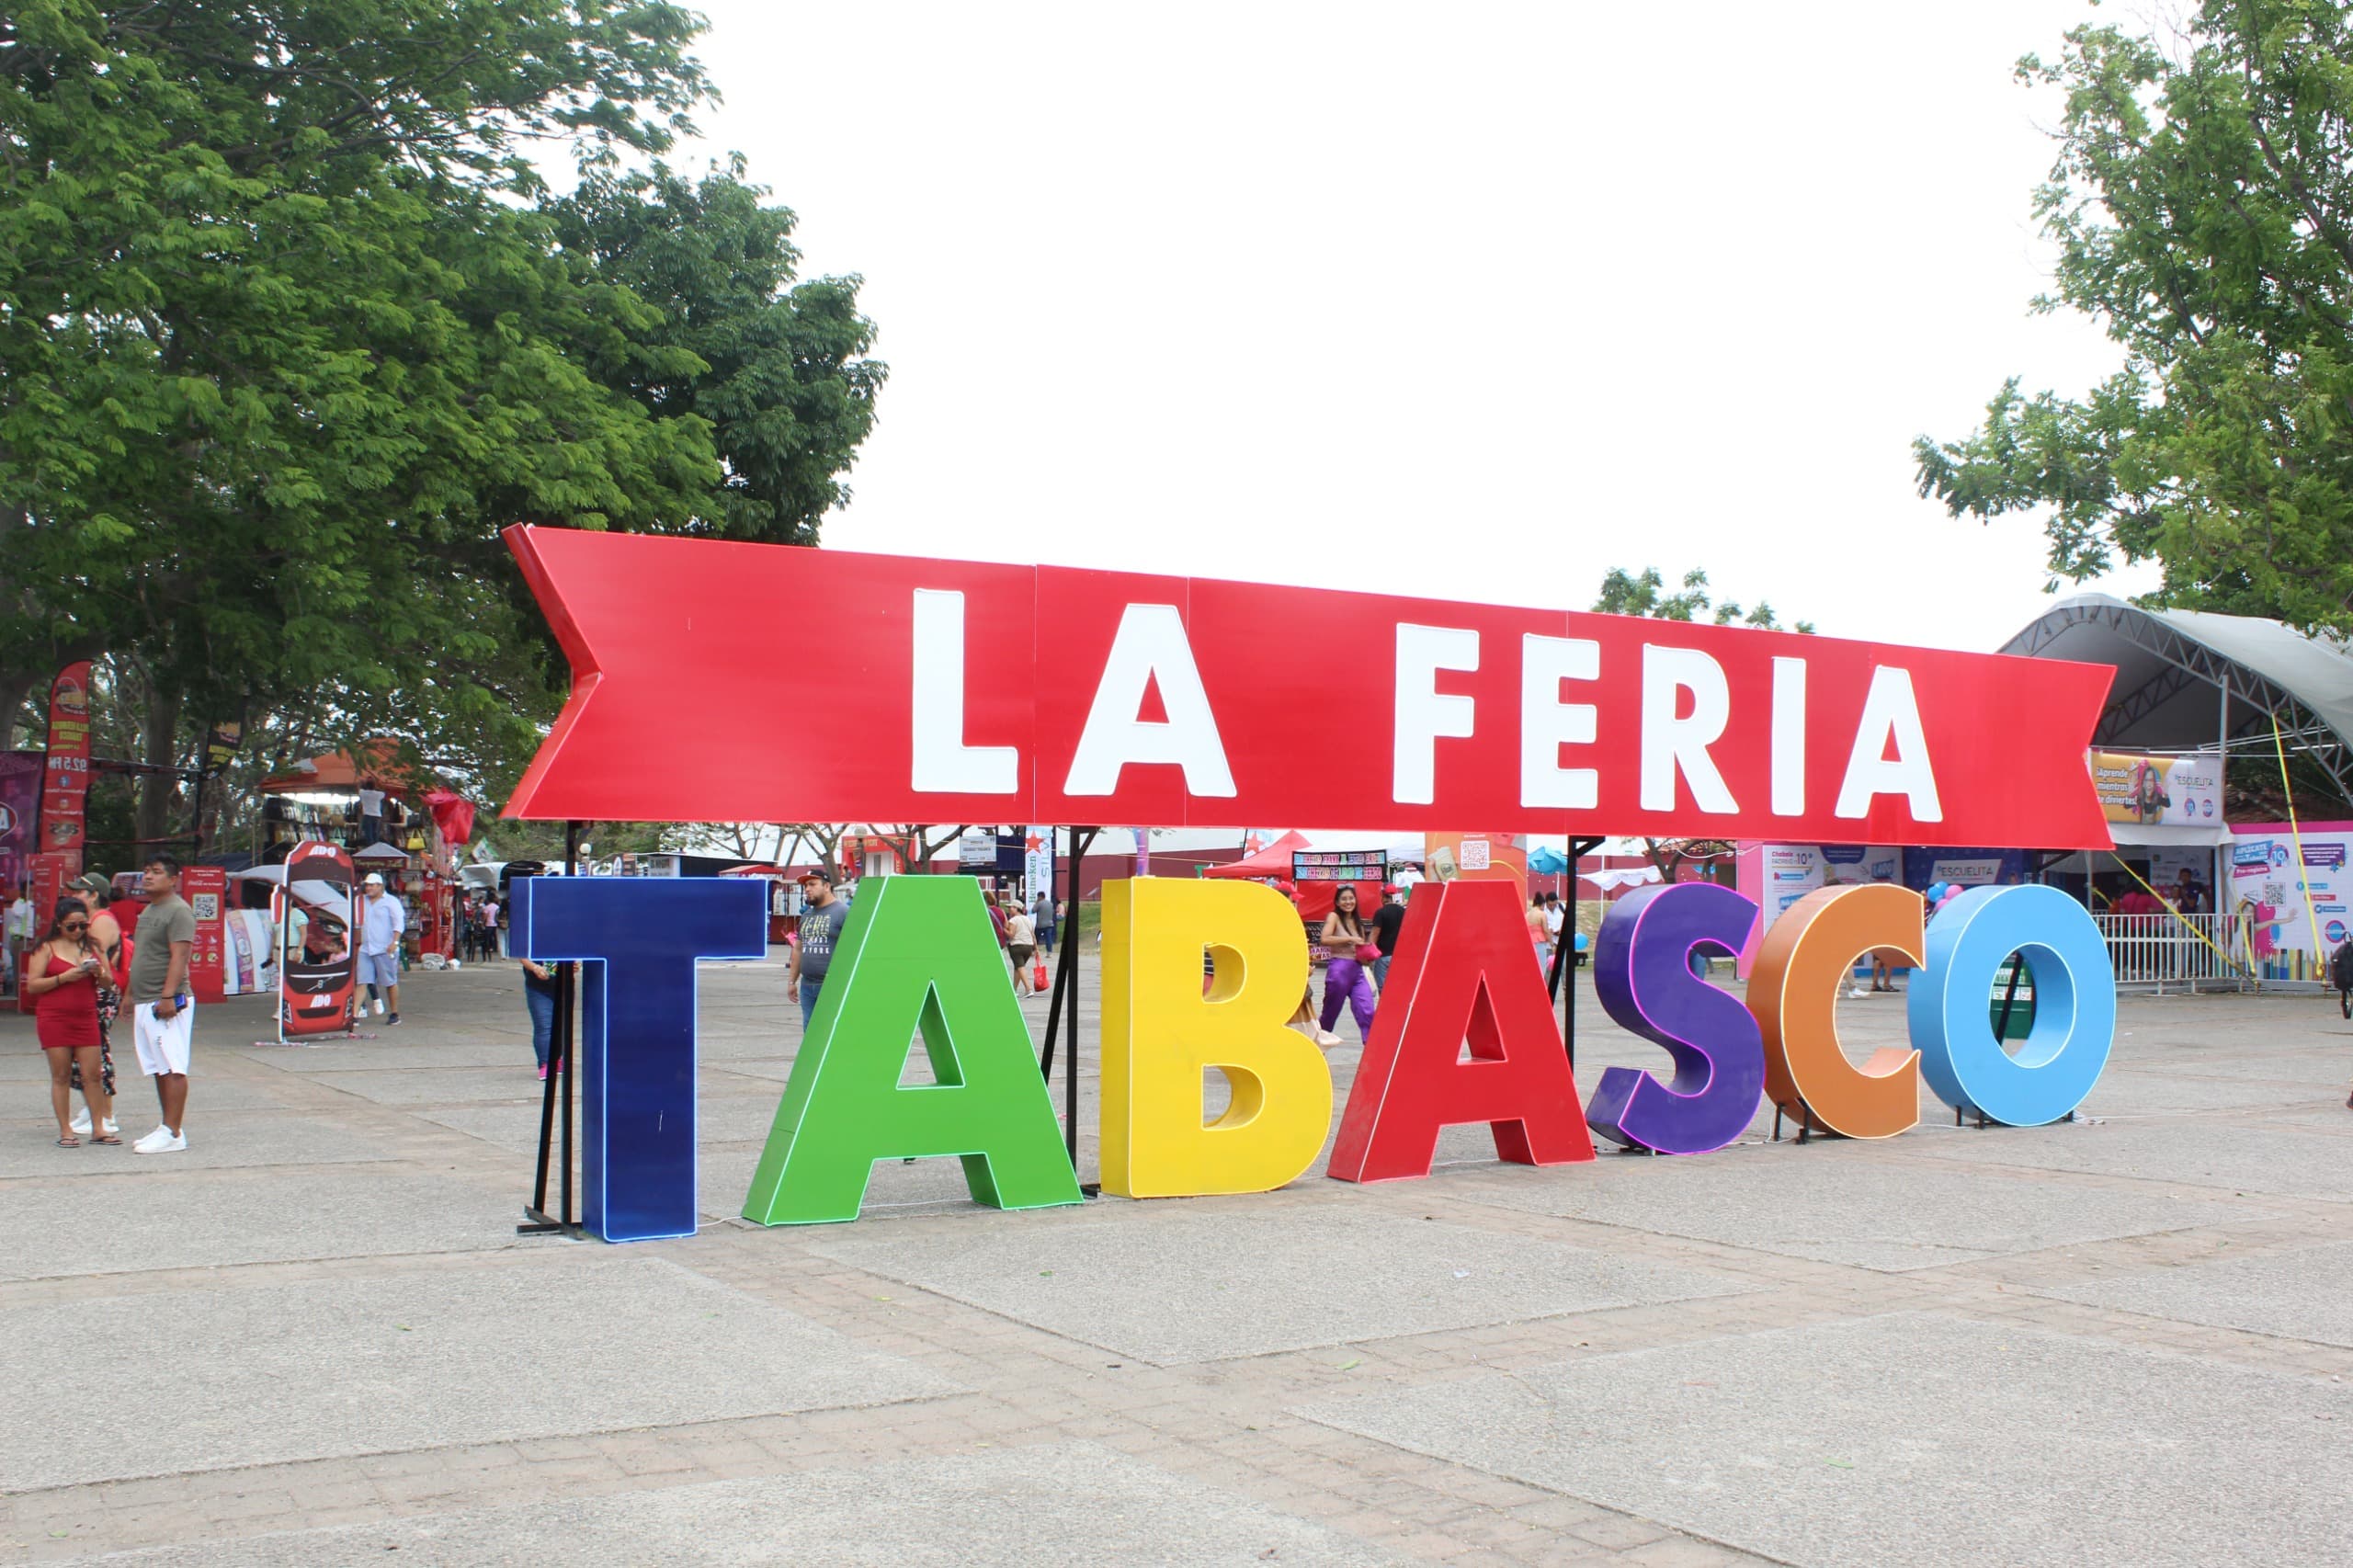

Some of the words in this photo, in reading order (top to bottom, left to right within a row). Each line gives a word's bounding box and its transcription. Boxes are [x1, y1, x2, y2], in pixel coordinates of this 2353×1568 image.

[910, 586, 1238, 798] LA
[1392, 621, 1944, 824] FERIA
[308, 845, 337, 858] ADO
[1028, 856, 1037, 903] Heineken
[1940, 866, 1994, 877] ESCUELITA
[310, 994, 332, 1007] ADO
[511, 872, 2117, 1244] TABASCO
